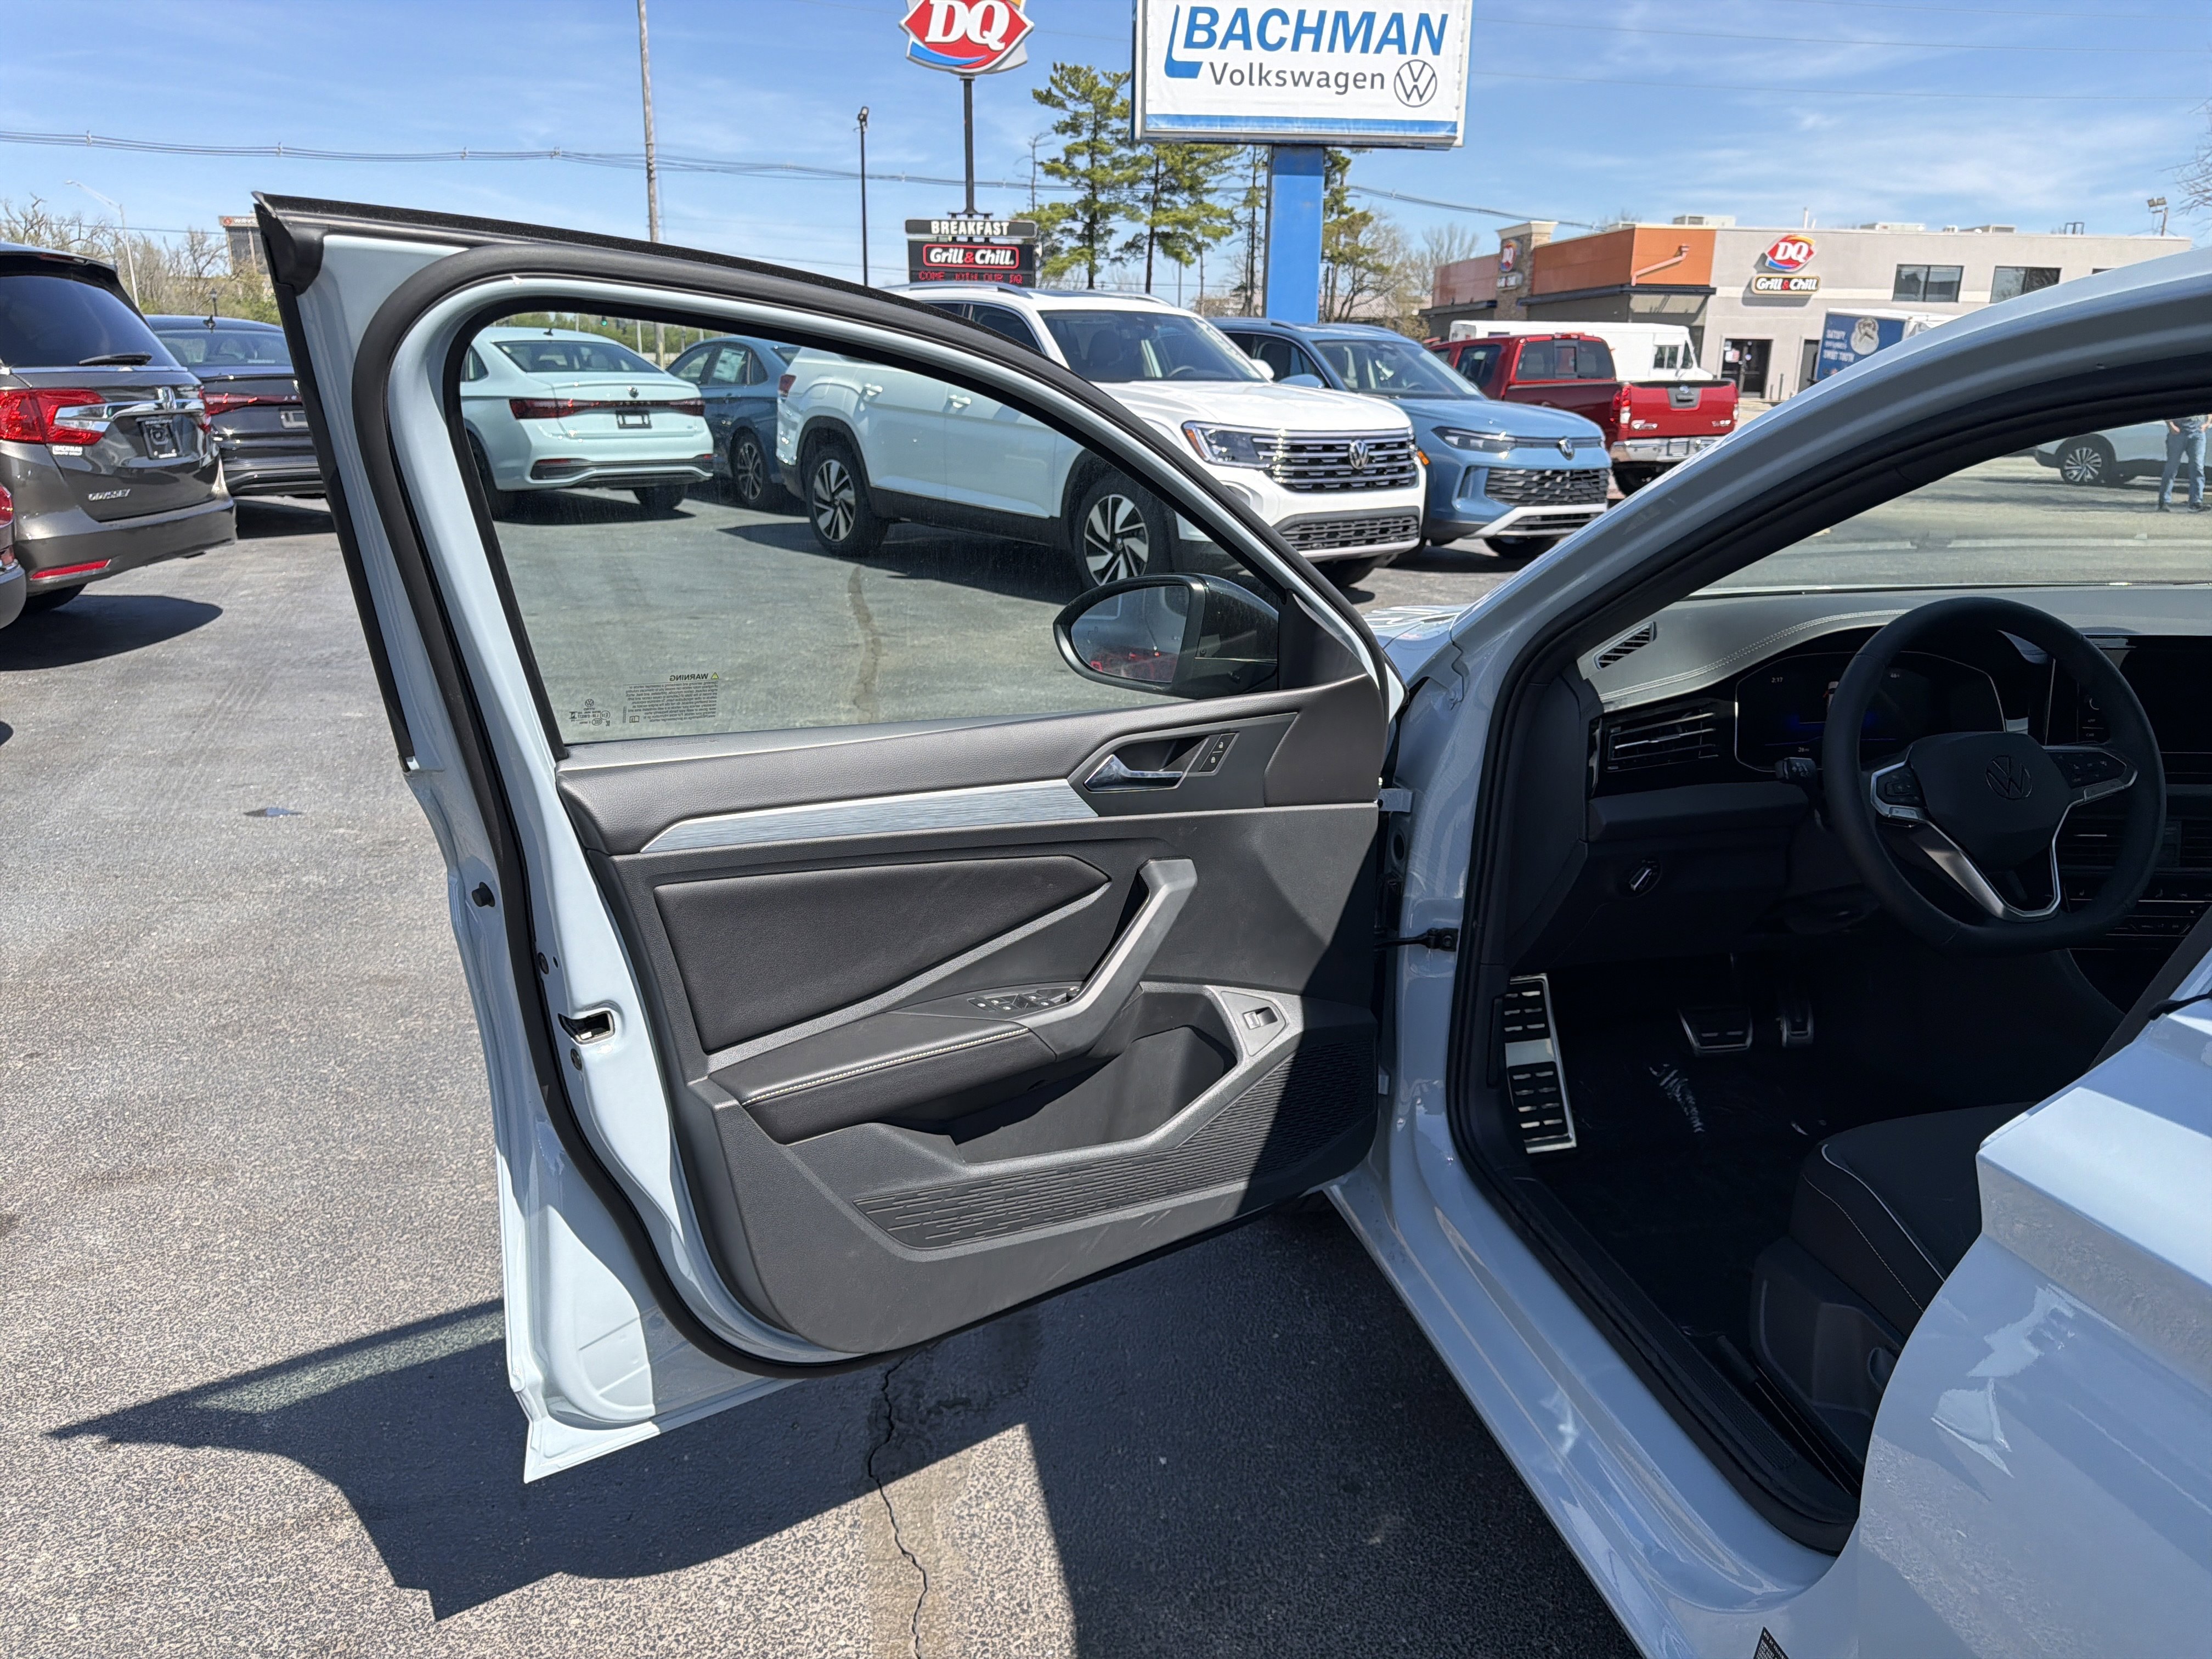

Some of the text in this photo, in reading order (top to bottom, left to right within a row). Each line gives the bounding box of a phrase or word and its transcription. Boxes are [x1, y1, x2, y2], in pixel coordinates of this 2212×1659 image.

[924, 0, 1010, 51] DQ
[1183, 6, 1448, 55] BACHMAN
[1209, 61, 1385, 95] Volkswagen
[931, 221, 1009, 236] BREAKFAST
[1774, 241, 1809, 263] DQ
